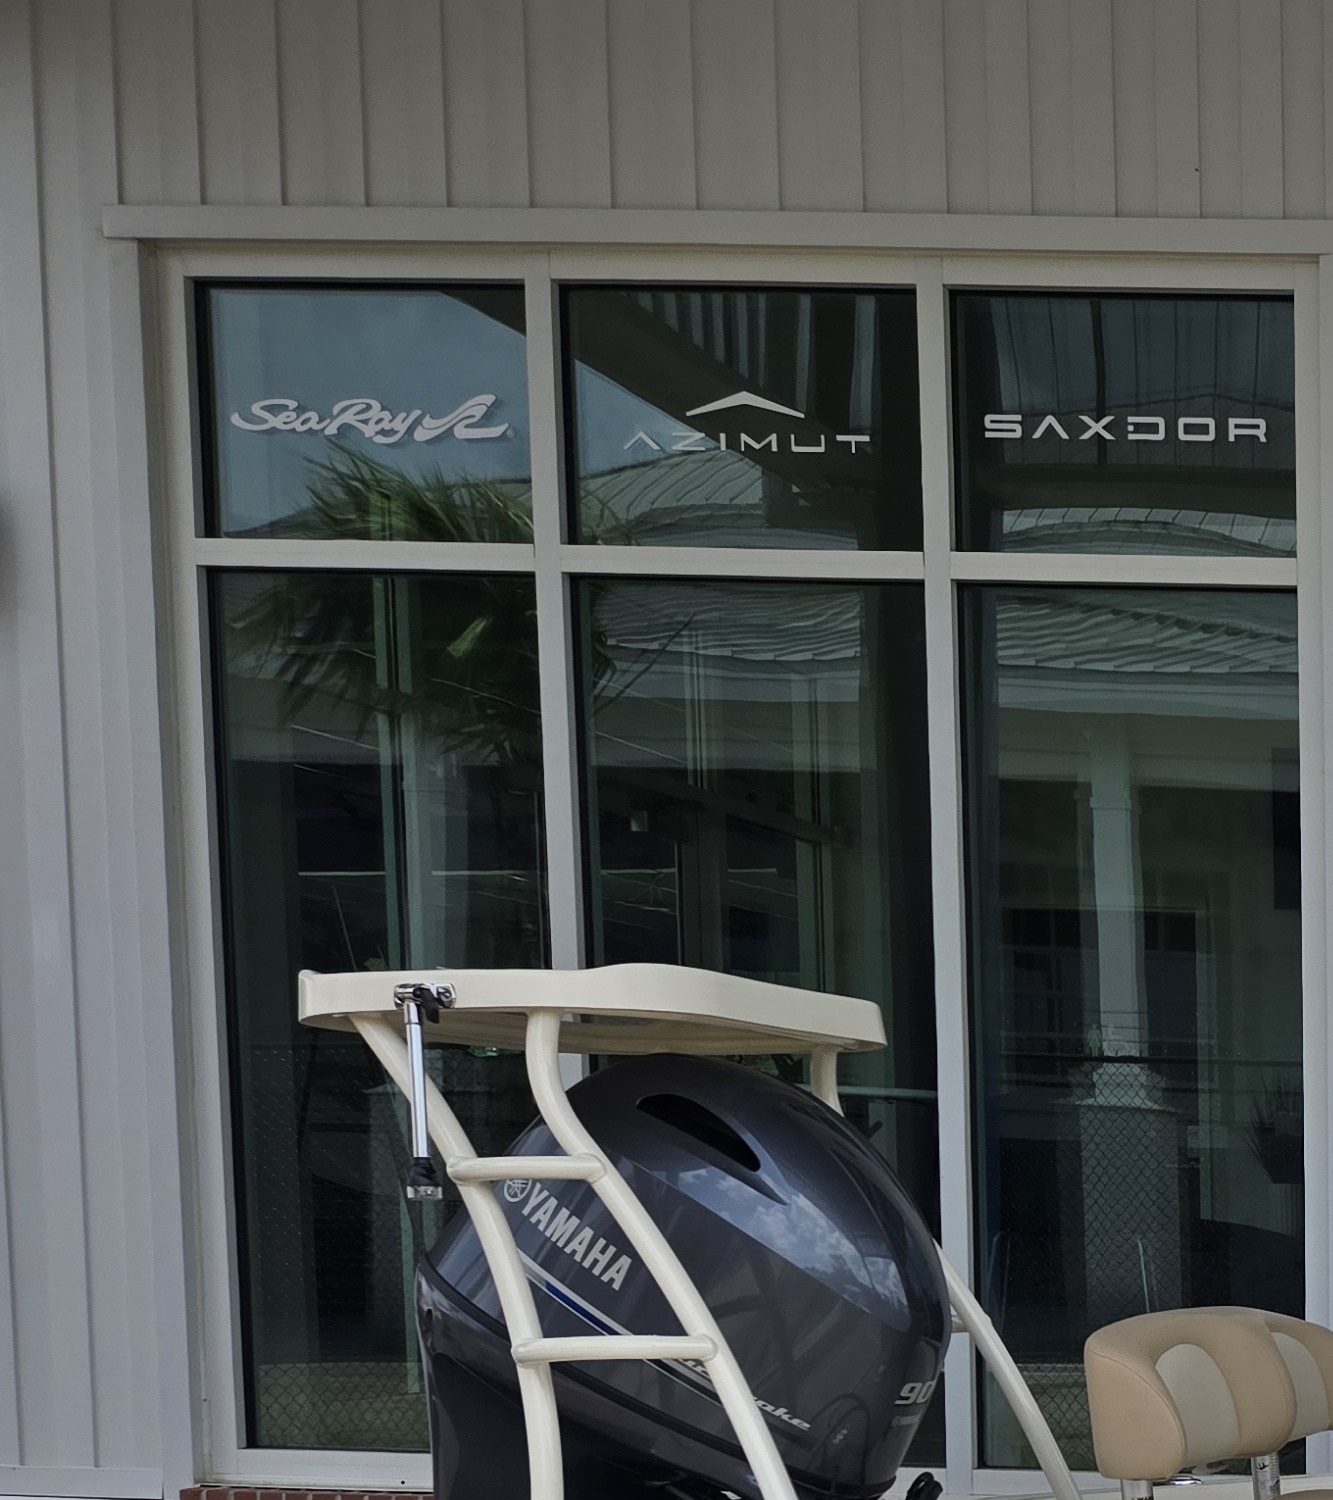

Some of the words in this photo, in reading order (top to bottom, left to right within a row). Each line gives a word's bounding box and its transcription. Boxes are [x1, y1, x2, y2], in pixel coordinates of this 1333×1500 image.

[984, 414, 1267, 442] SAXDOR
[624, 431, 870, 453] AZIMUT
[521, 1181, 632, 1291] YAMAHA
[894, 1381, 936, 1404] 90
